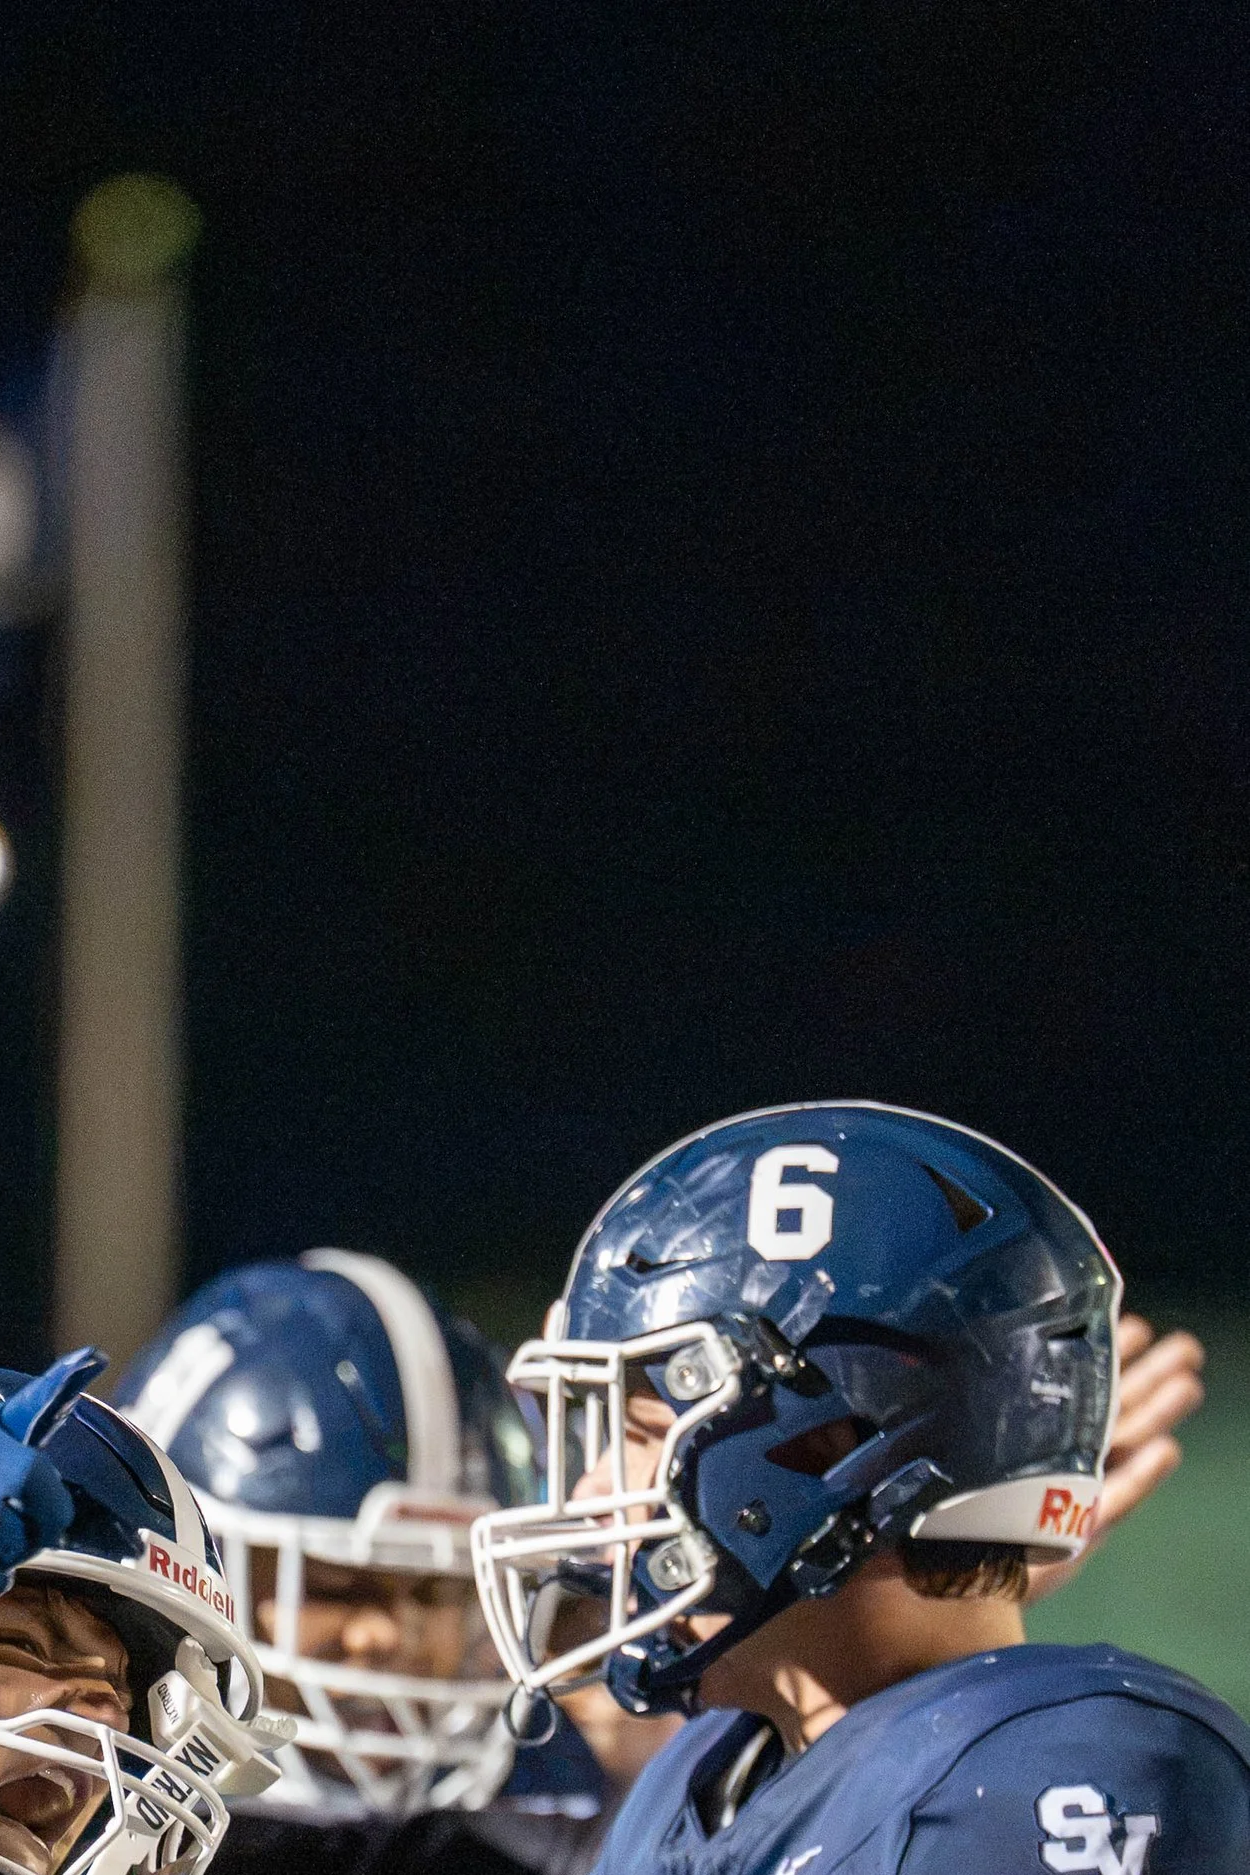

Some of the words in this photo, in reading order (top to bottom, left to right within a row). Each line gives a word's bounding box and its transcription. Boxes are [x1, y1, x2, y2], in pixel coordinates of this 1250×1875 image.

[747, 1144, 839, 1261] 6
[149, 1543, 235, 1625] Riddell
[136, 1734, 221, 1831] NXRD
